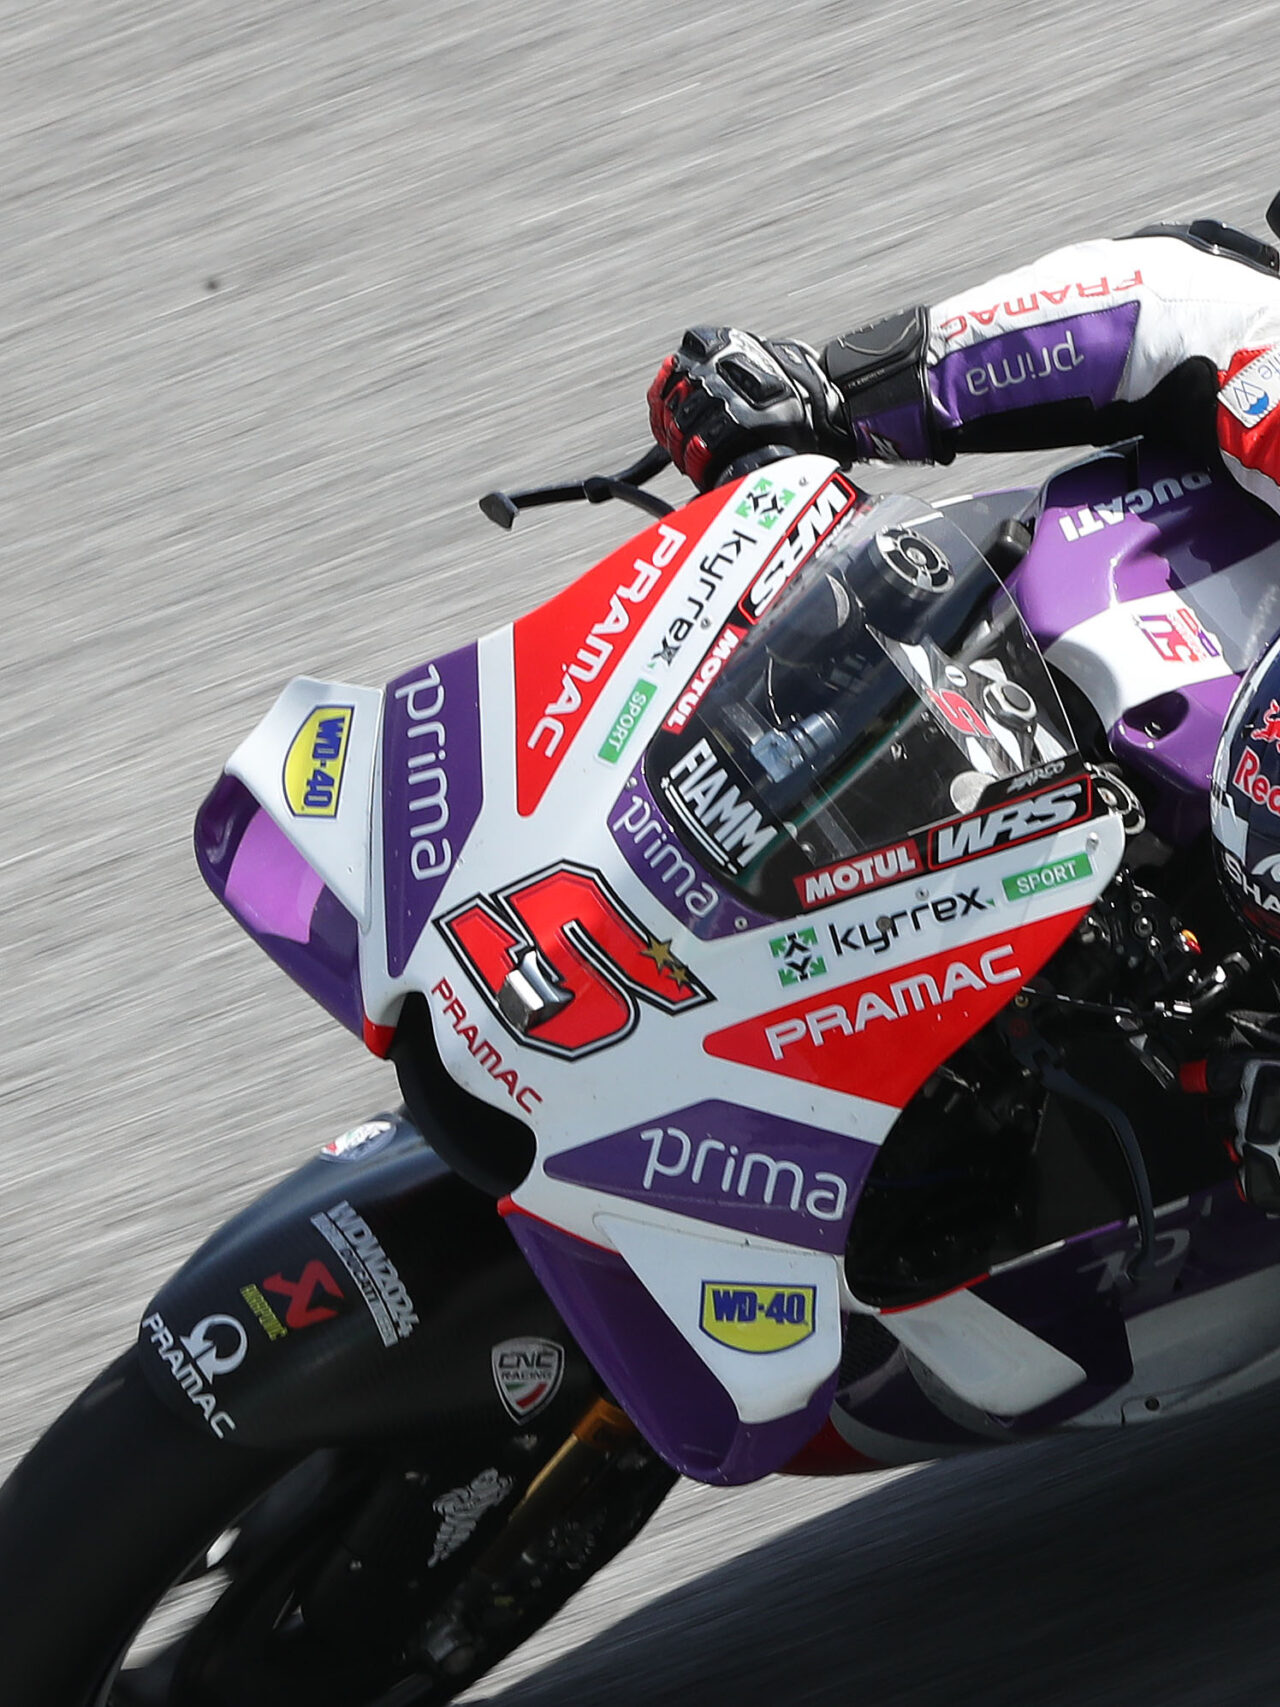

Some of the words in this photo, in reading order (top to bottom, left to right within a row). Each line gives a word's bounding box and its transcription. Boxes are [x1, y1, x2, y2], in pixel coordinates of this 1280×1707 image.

[966, 330, 1085, 396] prima
[752, 481, 847, 619] WRS
[1058, 472, 1212, 542] DUCATI
[527, 523, 687, 760] PRAMAC
[652, 529, 758, 666] kyrrex
[608, 688, 649, 755] SPORT
[667, 631, 741, 728] MOTUL
[303, 715, 346, 808] WD-40
[395, 664, 452, 881] prima
[671, 739, 777, 867] FIAMM
[614, 798, 719, 919] prima
[937, 783, 1081, 865] WRS
[805, 844, 918, 904] MOTUL
[1017, 862, 1079, 894] SPORT
[832, 886, 991, 963] kyrrex
[431, 978, 543, 1114] PRAMAC
[765, 944, 1022, 1060] PRAMAC
[640, 1127, 848, 1220] prima
[711, 1288, 808, 1326] WD-40
[141, 1312, 236, 1440] PRAMAC
[499, 1352, 555, 1368] CNC
